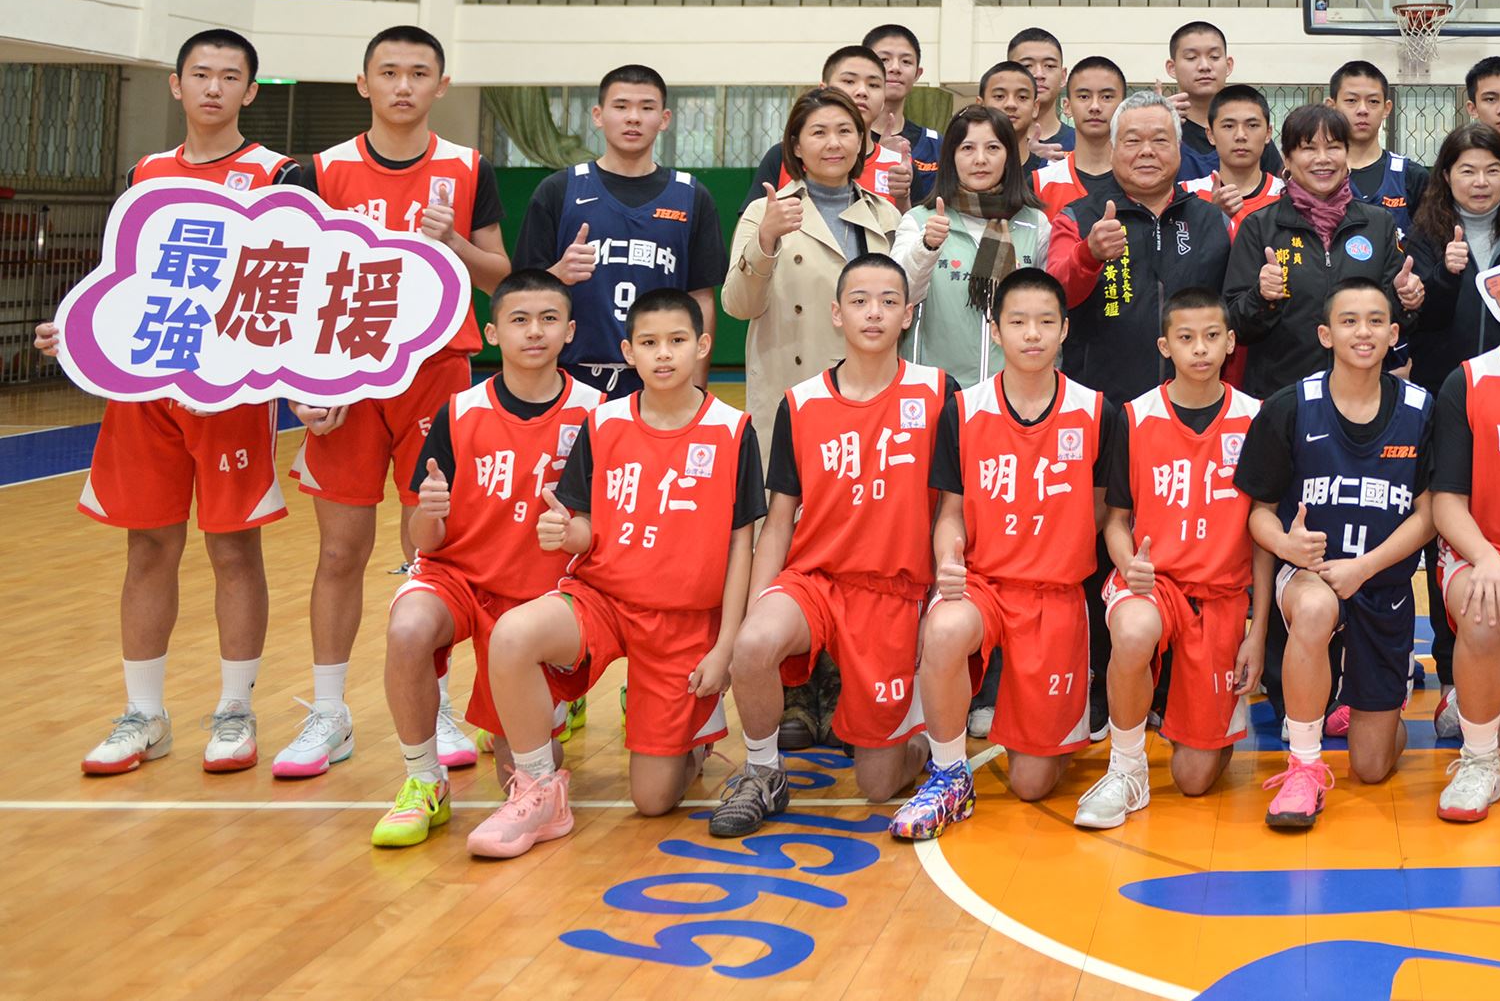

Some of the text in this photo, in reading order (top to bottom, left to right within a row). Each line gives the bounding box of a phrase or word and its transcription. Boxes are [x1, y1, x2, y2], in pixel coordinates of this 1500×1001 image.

[653, 208, 687, 222] JHBL
[1175, 220, 1192, 256] FILA
[131, 218, 227, 372] 最強
[214, 240, 402, 362] 應援
[1103, 264, 1120, 317] 黃道鑑
[219, 449, 249, 473] 43
[820, 428, 915, 480] 明仁
[1380, 445, 1418, 459] JHBL
[475, 450, 566, 501] 明仁
[606, 463, 698, 514] 明仁
[979, 454, 1072, 503] 明仁
[1152, 459, 1239, 509] 明仁
[852, 479, 885, 505] 20
[1302, 475, 1413, 515] 明仁國中
[513, 502, 528, 523] 9
[1005, 514, 1044, 536] 27
[618, 522, 658, 549] 25
[1180, 518, 1207, 541] 18
[1342, 524, 1367, 558] 4
[875, 679, 905, 702] 20
[1048, 672, 1074, 696] 27
[1213, 670, 1234, 694] 18
